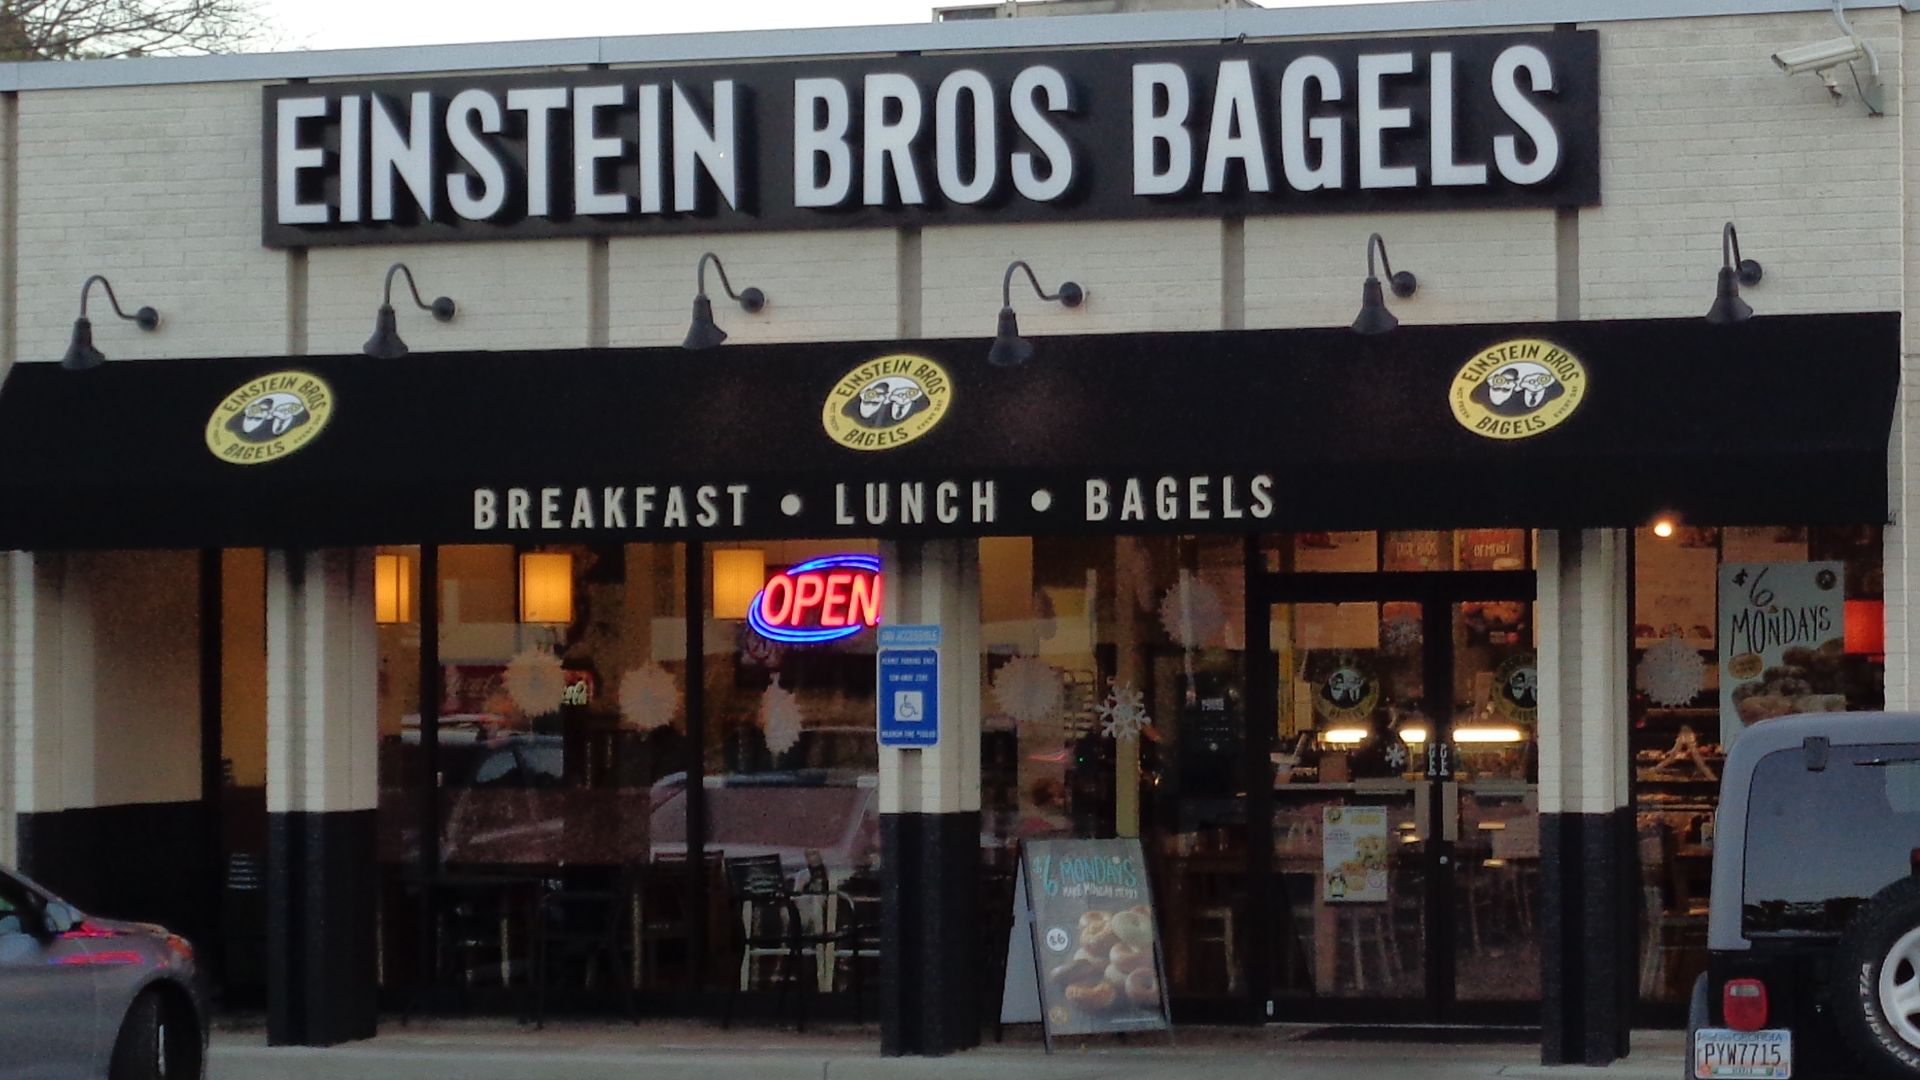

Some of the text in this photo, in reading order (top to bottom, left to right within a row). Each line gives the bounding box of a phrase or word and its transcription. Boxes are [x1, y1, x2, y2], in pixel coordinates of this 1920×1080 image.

[275, 45, 1560, 225] EINSTEIN BROS BAGELS
[836, 359, 946, 397] EINSTEIN BROS
[1462, 344, 1579, 383] EINSTEIN BROS
[222, 376, 327, 413] EINSTEIN BROS
[843, 427, 909, 447] BAGELS
[1475, 415, 1546, 435] BAGELS
[223, 440, 285, 460] BAGELS
[473, 475, 1275, 530] BREAKFAST LUNCH BAGELS
[761, 574, 880, 626] OPEN
[1732, 566, 1775, 608] $6
[1730, 605, 1831, 656] MONDAYS
[1060, 856, 1137, 889] MONDAYS
[1705, 1042, 1781, 1066] PYW7715
